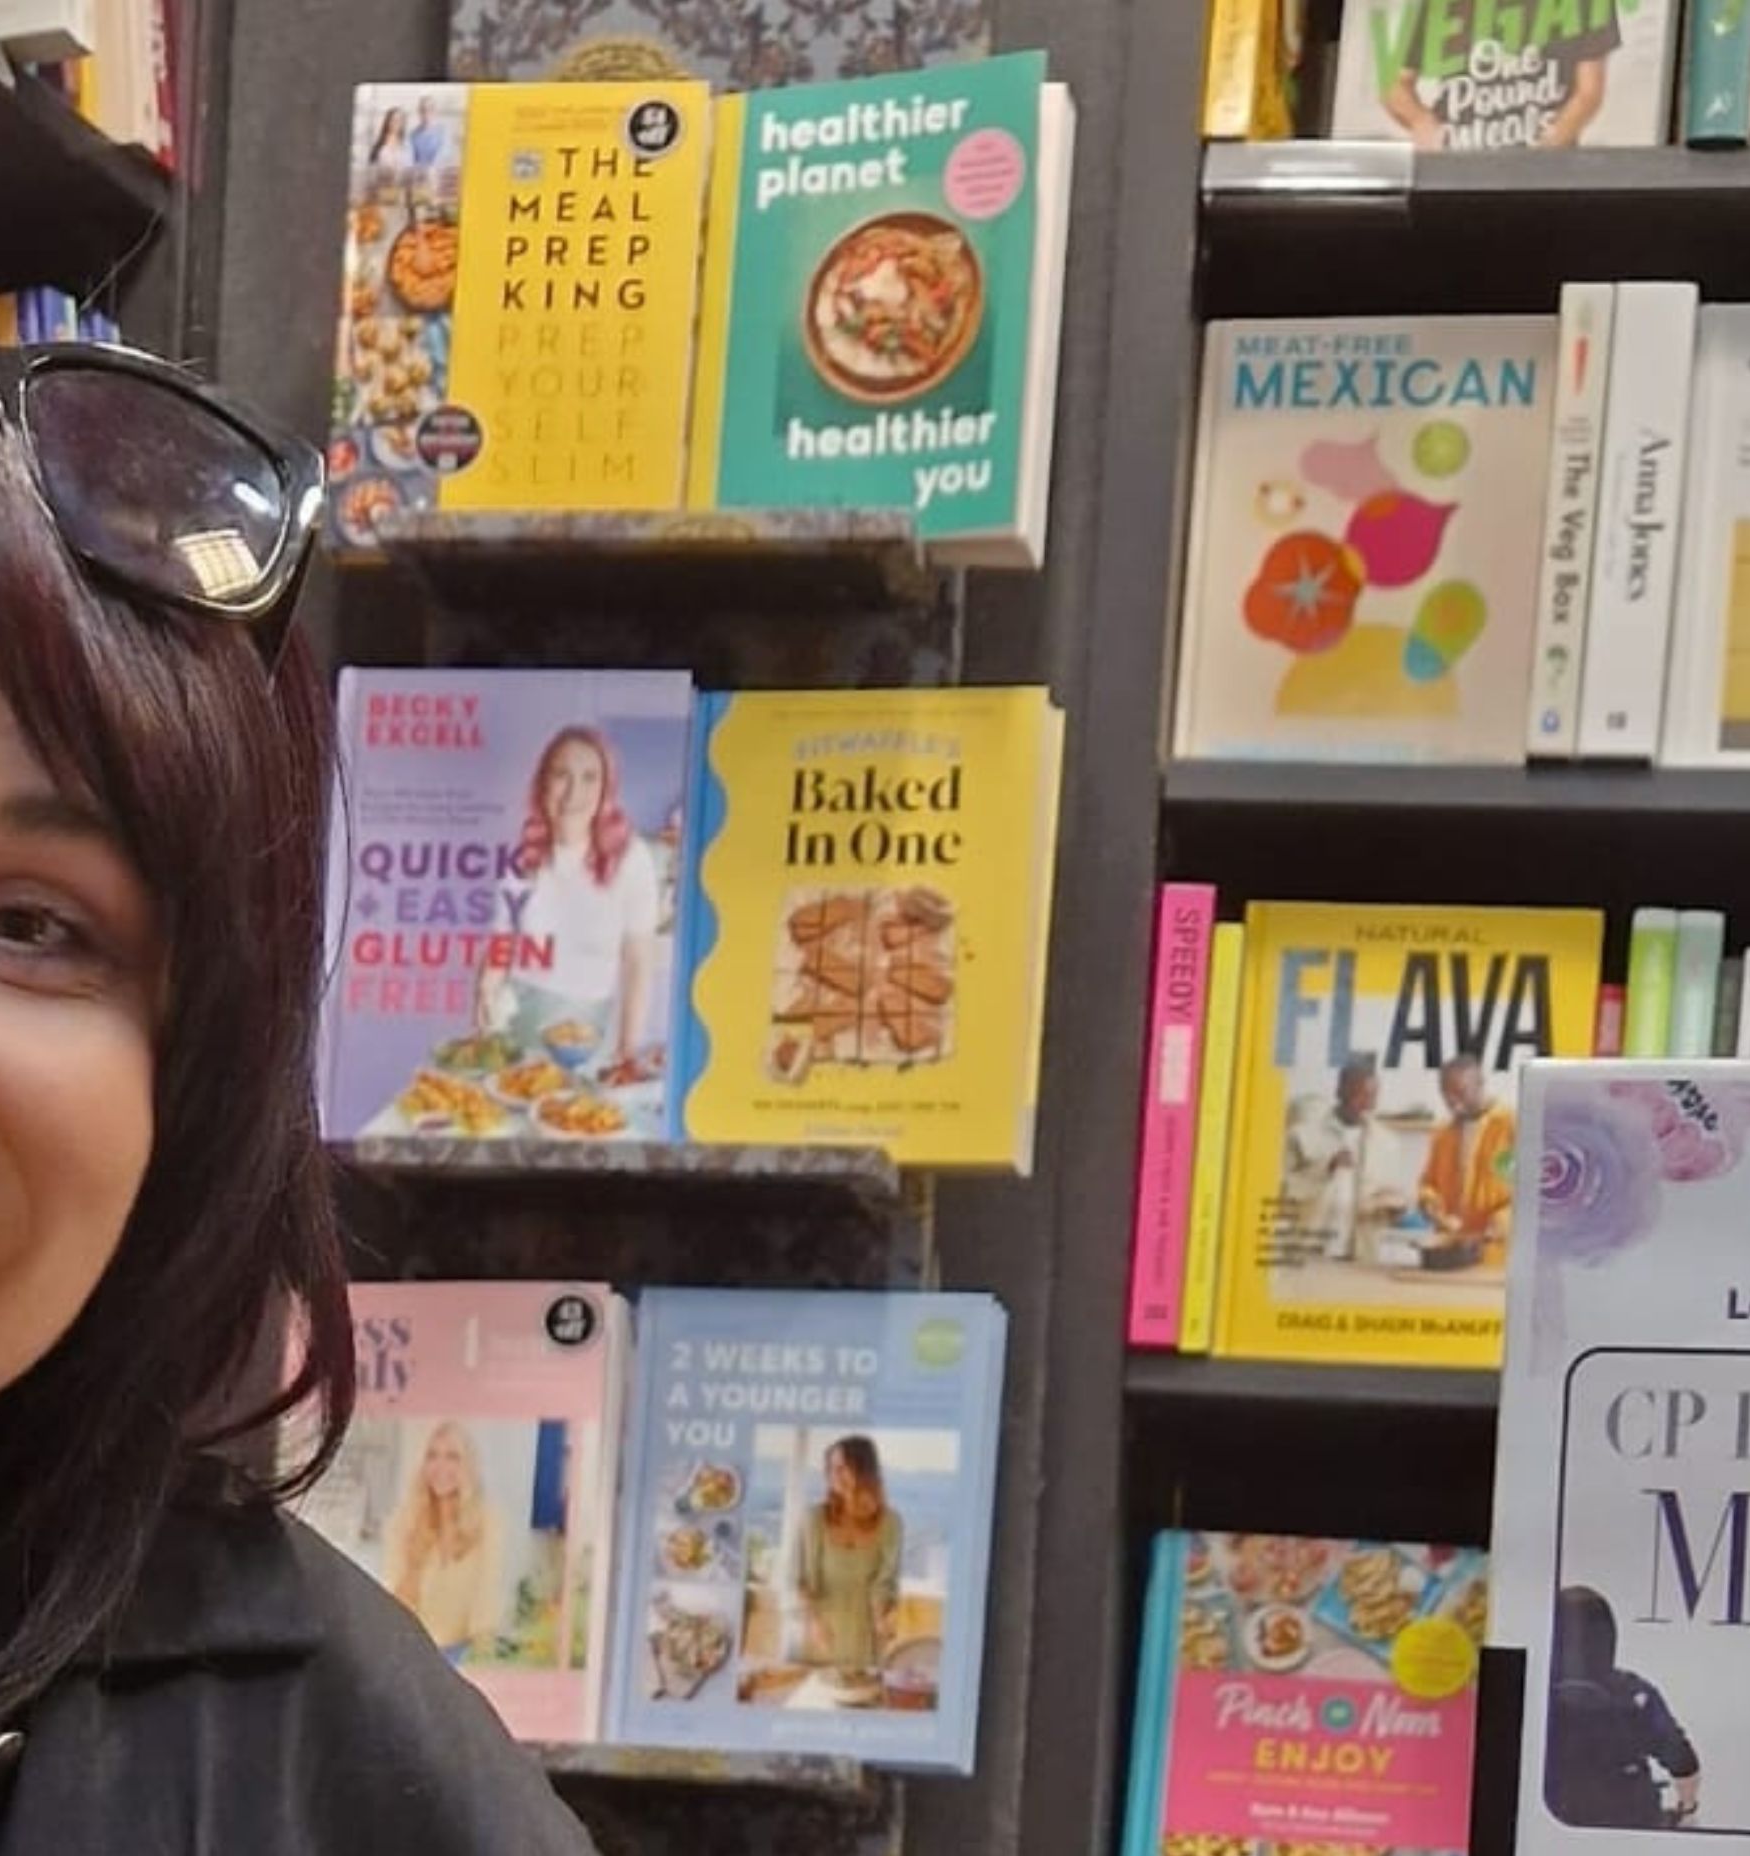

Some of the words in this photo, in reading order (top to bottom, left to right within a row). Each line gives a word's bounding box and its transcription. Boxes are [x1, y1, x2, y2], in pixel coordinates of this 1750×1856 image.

[760, 94, 970, 153] healthier
[558, 147, 655, 178] THE
[757, 147, 907, 209] planet
[507, 191, 653, 223] MEAL
[504, 235, 653, 267] PREP
[501, 278, 648, 311] KING
[1233, 334, 1413, 357] MEAT-FREE
[1231, 358, 1538, 409] MEXICAN
[786, 406, 998, 461] healthier
[914, 460, 992, 506] you
[1563, 452, 1590, 499] The
[1630, 428, 1672, 516] Anna
[1550, 509, 1586, 561] Veg
[1551, 570, 1579, 625] Box
[367, 692, 481, 722] BECKY
[365, 720, 485, 749] EXCELL
[792, 765, 963, 814] Baked
[358, 841, 527, 880] QUICK
[784, 821, 837, 868] In
[848, 819, 963, 868] One
[395, 888, 534, 927] EASY
[350, 932, 555, 972] GLUTEN
[1167, 907, 1202, 1021] SPEEDY
[347, 977, 469, 1016] FREE
[669, 1341, 692, 1374] 2
[704, 1341, 826, 1377] WEEKS
[835, 1345, 878, 1377] TO
[666, 1383, 689, 1412] A
[699, 1383, 866, 1415] YOUNGER
[664, 1420, 738, 1450] YOU
[1605, 1388, 1708, 1461] CP
[1214, 1681, 1314, 1735] Pinch
[1254, 1736, 1395, 1775] ENJOY
